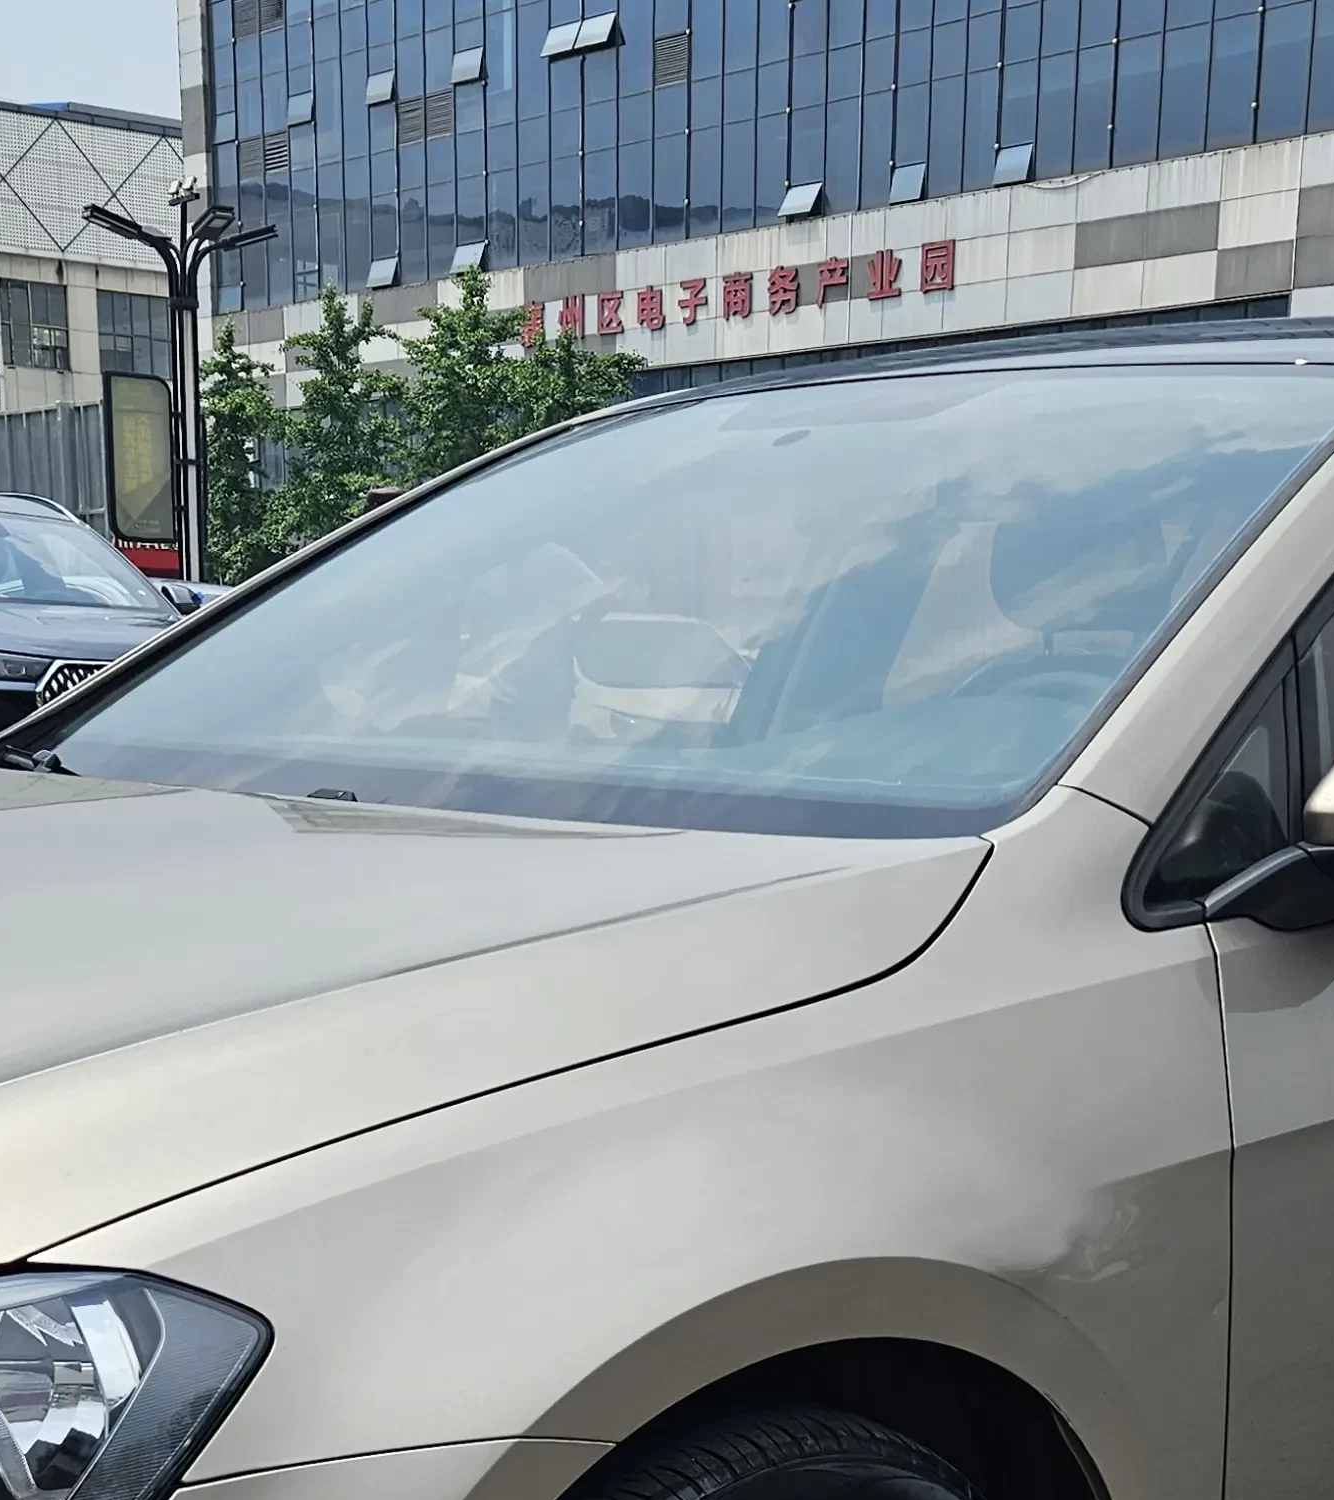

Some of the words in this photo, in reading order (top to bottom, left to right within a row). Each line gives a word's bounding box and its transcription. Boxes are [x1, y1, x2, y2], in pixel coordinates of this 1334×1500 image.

[520, 239, 956, 347] 襄州区电子商务产业园
